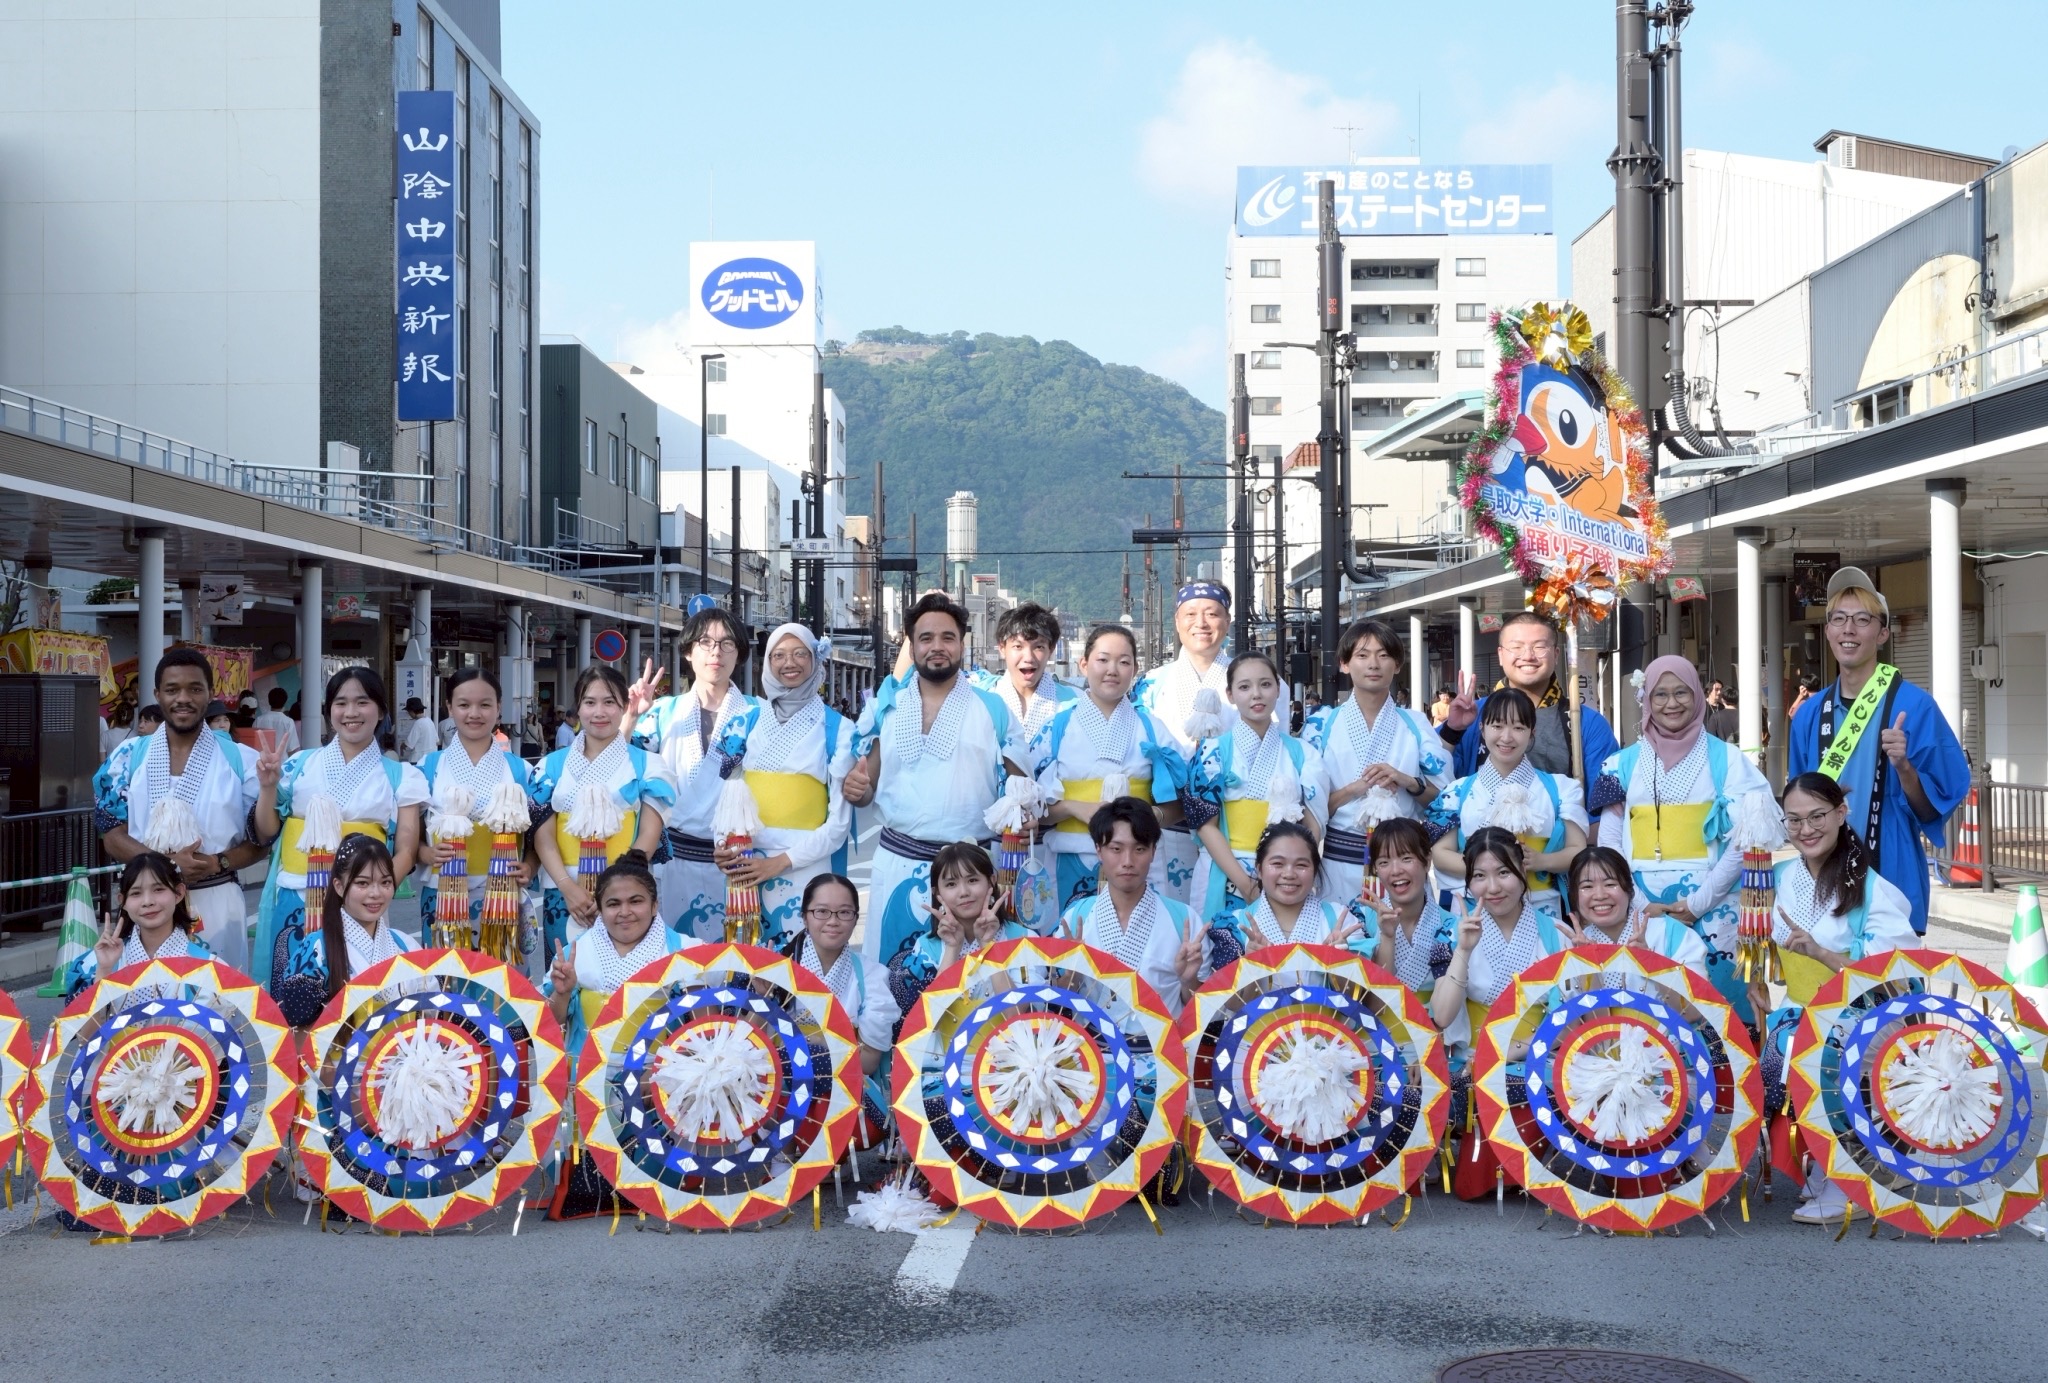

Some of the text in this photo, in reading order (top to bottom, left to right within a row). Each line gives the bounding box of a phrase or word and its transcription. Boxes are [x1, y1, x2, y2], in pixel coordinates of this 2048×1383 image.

[1303, 169, 1474, 191] 不動産のことなら
[1301, 194, 1546, 228] エステートセンター
[403, 127, 452, 383] 山陰中央新報
[709, 288, 799, 312] グッドヒル
[1526, 527, 1615, 577] 踊り子隊
[406, 670, 415, 697] 本通り
